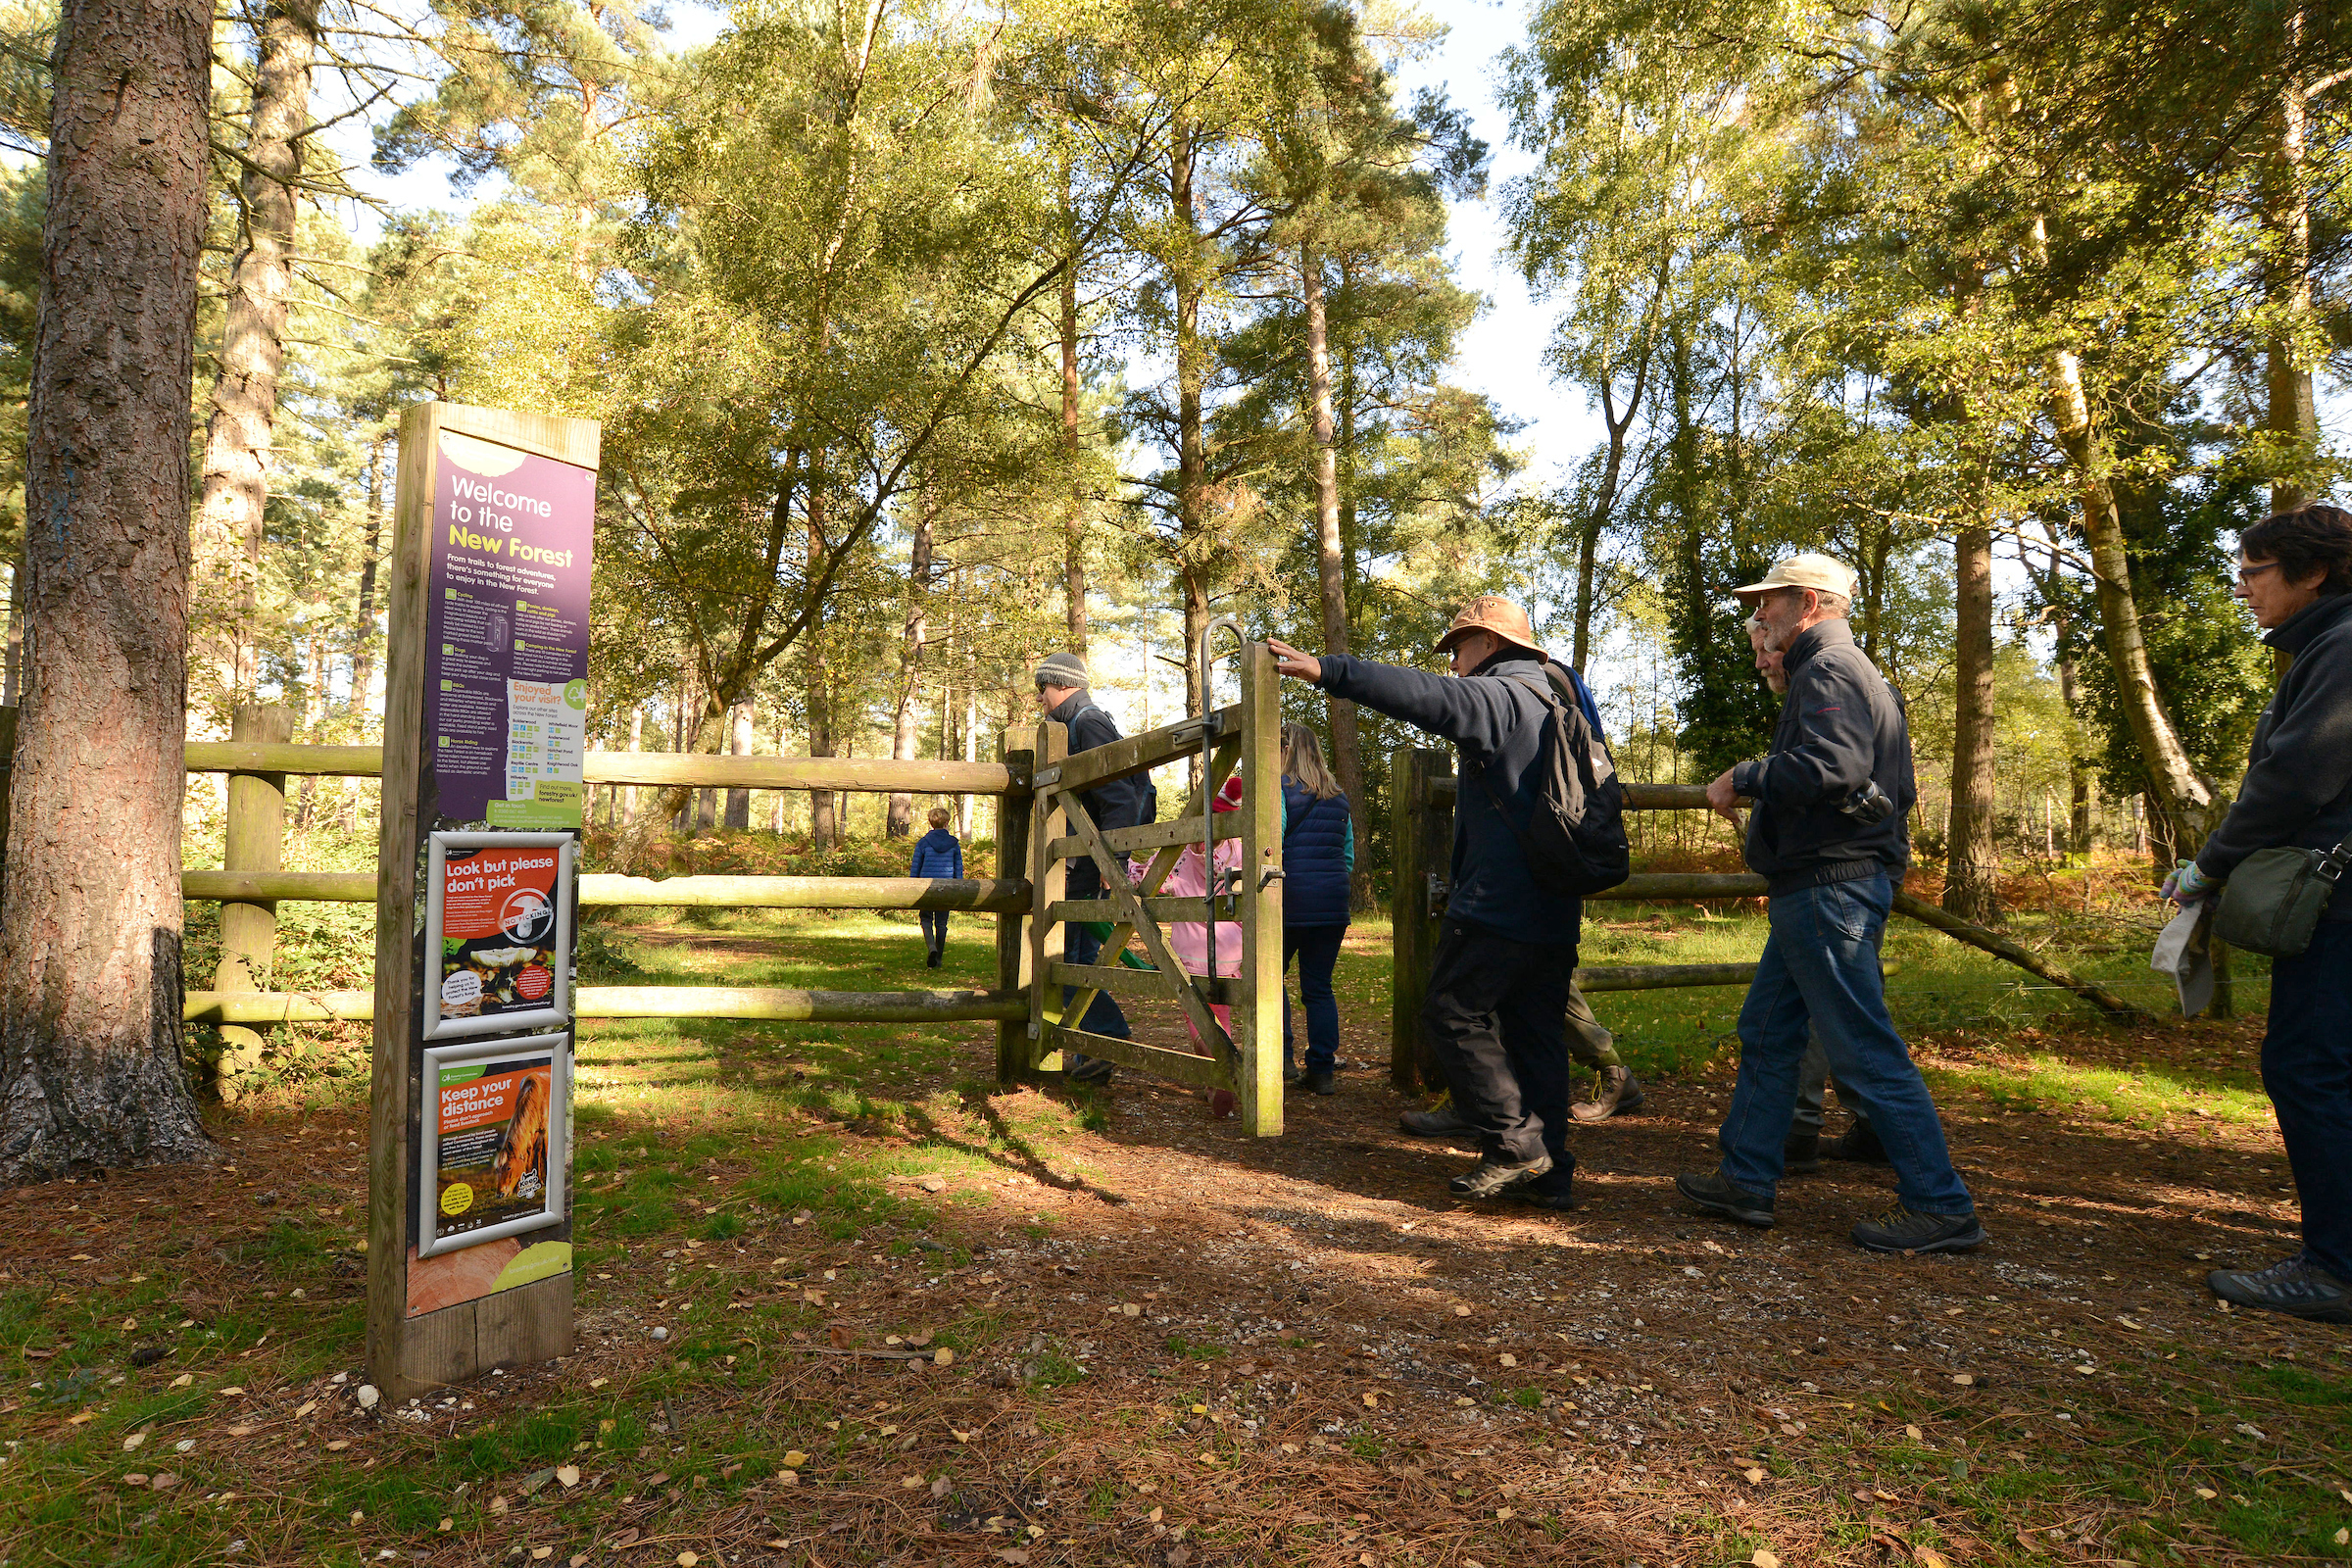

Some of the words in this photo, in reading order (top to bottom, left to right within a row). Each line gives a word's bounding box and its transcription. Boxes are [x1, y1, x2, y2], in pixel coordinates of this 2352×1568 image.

[451, 474, 552, 517] Welcome
[450, 500, 472, 523] to
[478, 507, 513, 532] the
[449, 524, 503, 554] New
[509, 538, 573, 568] Forest
[446, 563, 472, 574] there's
[473, 568, 511, 582] something
[523, 578, 554, 589] everyone
[447, 553, 466, 563] From
[467, 557, 486, 567] trails
[496, 562, 516, 572] forest
[517, 567, 556, 581] adventures,
[446, 572, 454, 580] to
[456, 574, 476, 585] enjoy
[477, 577, 484, 585] in
[486, 579, 498, 588] the
[499, 582, 515, 590] New
[516, 585, 539, 595] Forest.
[514, 682, 551, 695] Enjoyed
[514, 694, 536, 703] your
[539, 695, 561, 704] visit?
[446, 861, 480, 877] Look
[484, 859, 507, 873] but
[510, 857, 554, 874] please
[447, 877, 484, 892] don't
[488, 874, 516, 892] pick
[442, 1087, 478, 1104] Keep
[482, 1079, 512, 1097] your
[443, 1095, 504, 1117] distance
[472, 1111, 493, 1119] approach
[518, 1184, 540, 1196] distance
[520, 1177, 538, 1187] Keep
